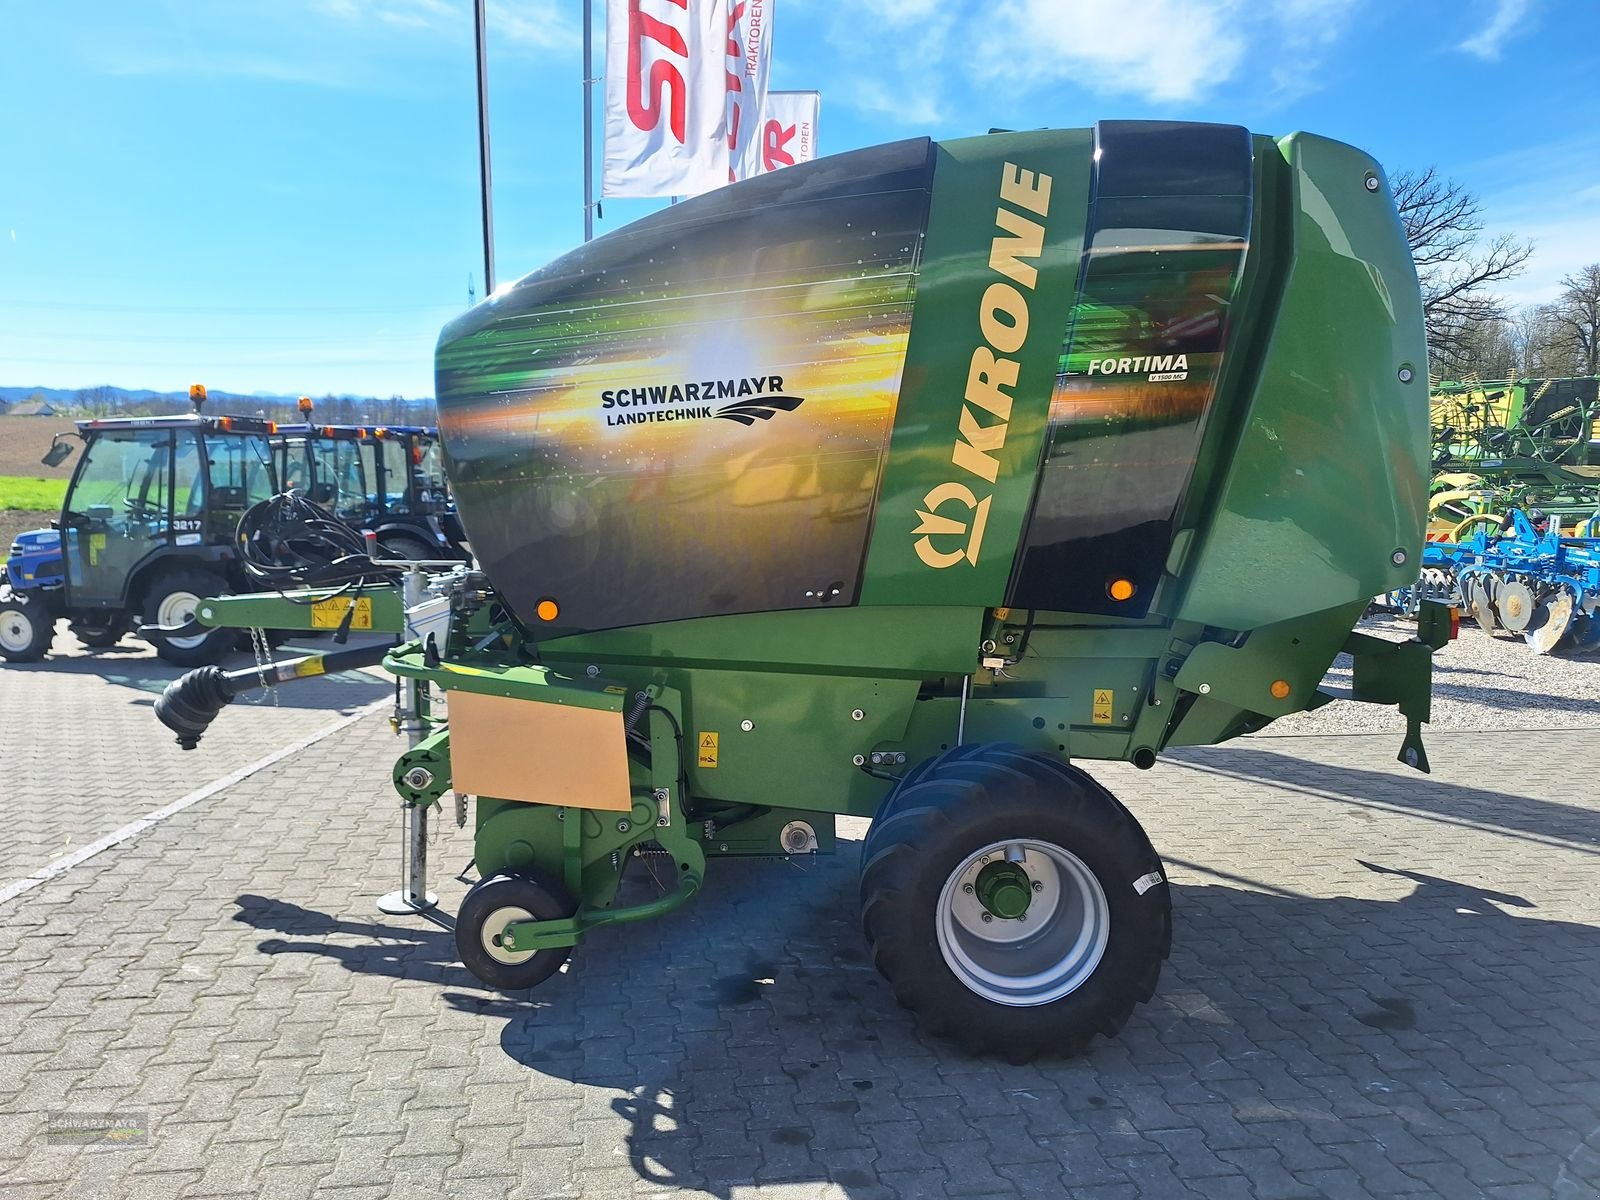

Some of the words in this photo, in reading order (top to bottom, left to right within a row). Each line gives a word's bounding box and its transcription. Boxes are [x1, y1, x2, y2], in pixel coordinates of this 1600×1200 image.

[744, 0, 763, 78] TRAKTOREN
[799, 121, 810, 162] TOREN
[951, 161, 1053, 484] KRONE
[1087, 354, 1189, 376] FORTIMA
[601, 375, 784, 409] SCHWARZMAYR
[606, 406, 713, 426] LANDTECHNIK
